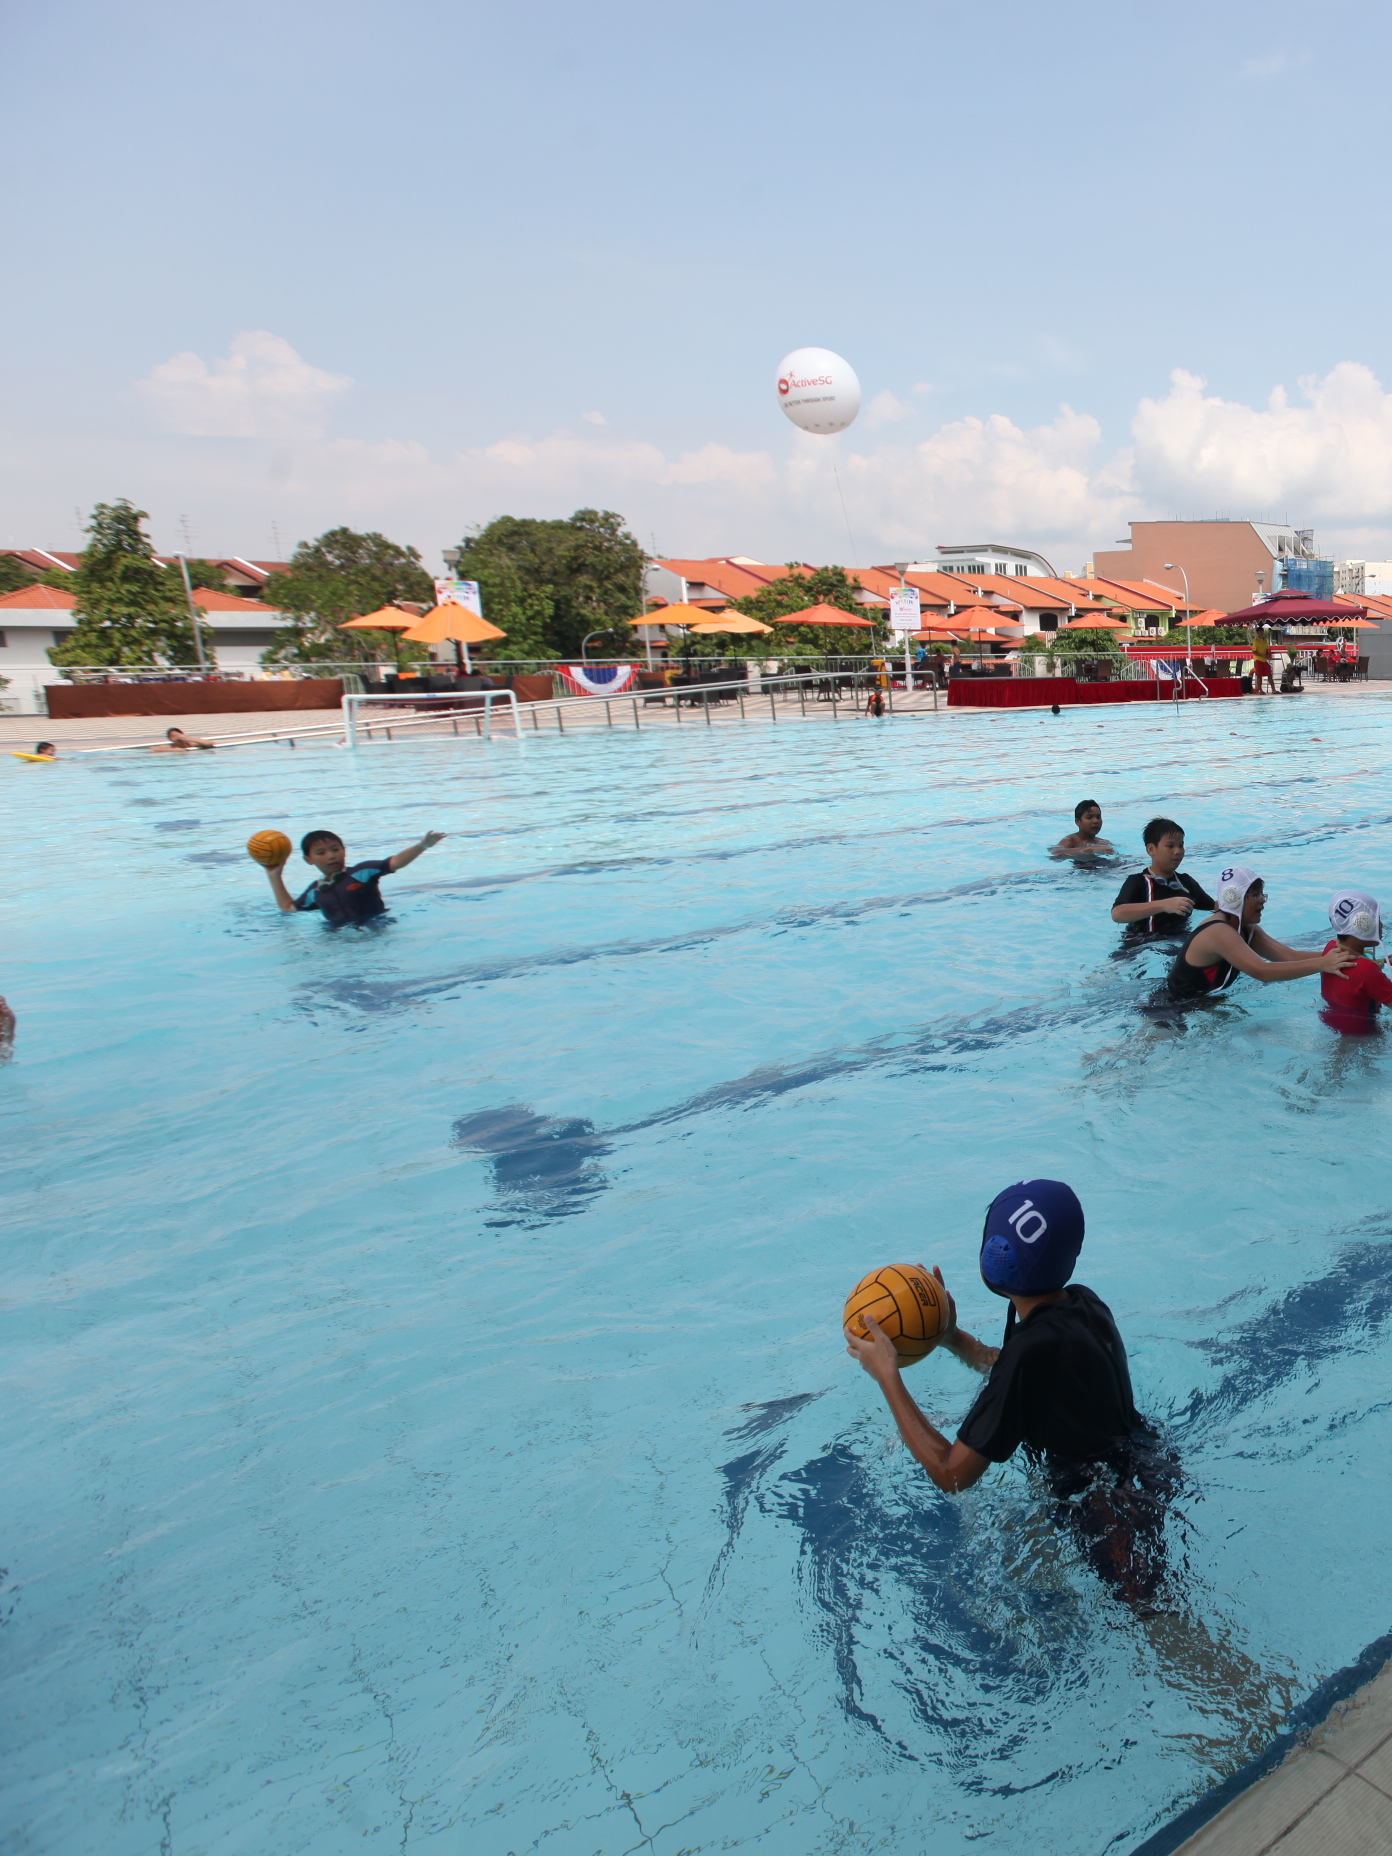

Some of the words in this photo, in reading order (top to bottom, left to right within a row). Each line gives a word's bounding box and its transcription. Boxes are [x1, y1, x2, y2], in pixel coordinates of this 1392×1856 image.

[790, 375, 833, 389] ActiveSG
[1221, 868, 1234, 882] 8
[1335, 899, 1354, 920] 10
[1008, 1199, 1047, 1244] 10
